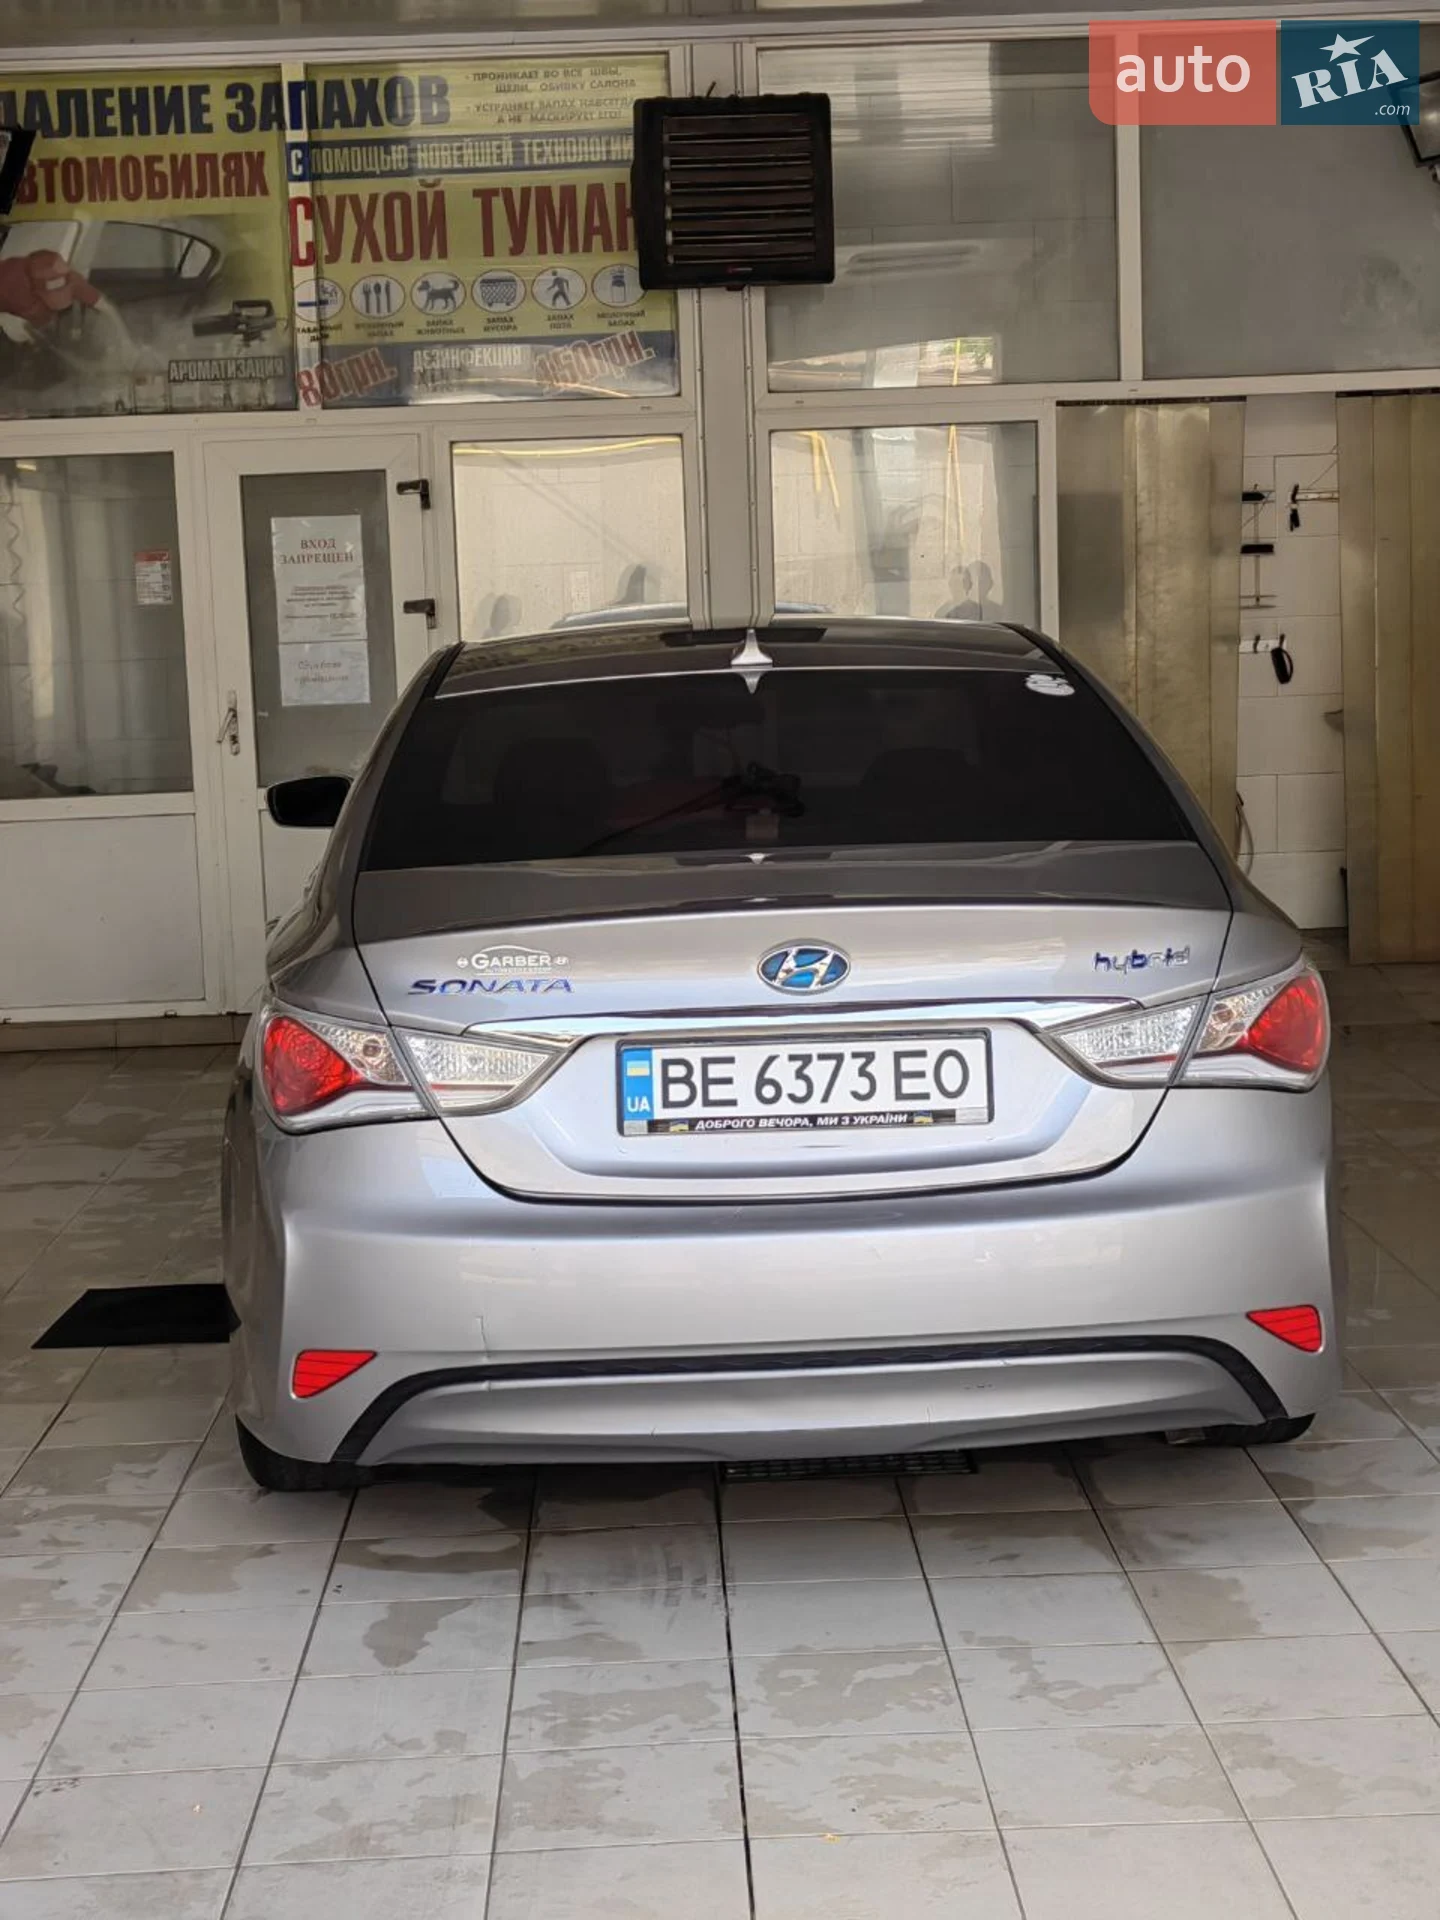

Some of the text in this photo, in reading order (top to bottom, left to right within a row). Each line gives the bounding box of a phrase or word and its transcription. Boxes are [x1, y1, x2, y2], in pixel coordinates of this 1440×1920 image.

[473, 70, 538, 81] ПРОНИКАЕТ
[544, 69, 559, 79] ВО
[540, 81, 585, 92] ОБИВКУ
[590, 78, 637, 89] САЛОНА
[225, 75, 451, 133] ЗАПАХОВ
[291, 134, 634, 176] С ПОМОЩЬЮ НОВЕЙШЕЙ ТЕХНОЛОГИИ
[16, 151, 270, 205] ВТОМОБИЛЯХ
[289, 178, 449, 268] СУХОЙ
[169, 356, 285, 381] АРОМАТИЗАЦИЯ
[412, 346, 521, 373] ДЕЗИНФЕКЦИЯ
[300, 538, 337, 550] ВХОД
[280, 551, 354, 565] ЗАПРЕЩЕН
[471, 952, 552, 970] GARBER
[1094, 944, 1191, 976] hybrid
[408, 977, 574, 996] SONATA
[660, 1048, 970, 1110] BE 6373 EO
[626, 1096, 651, 1114] UA
[694, 1112, 908, 1131] ДОБРОГО ВЕЧОРА, МИ З УКРАЇНИ
